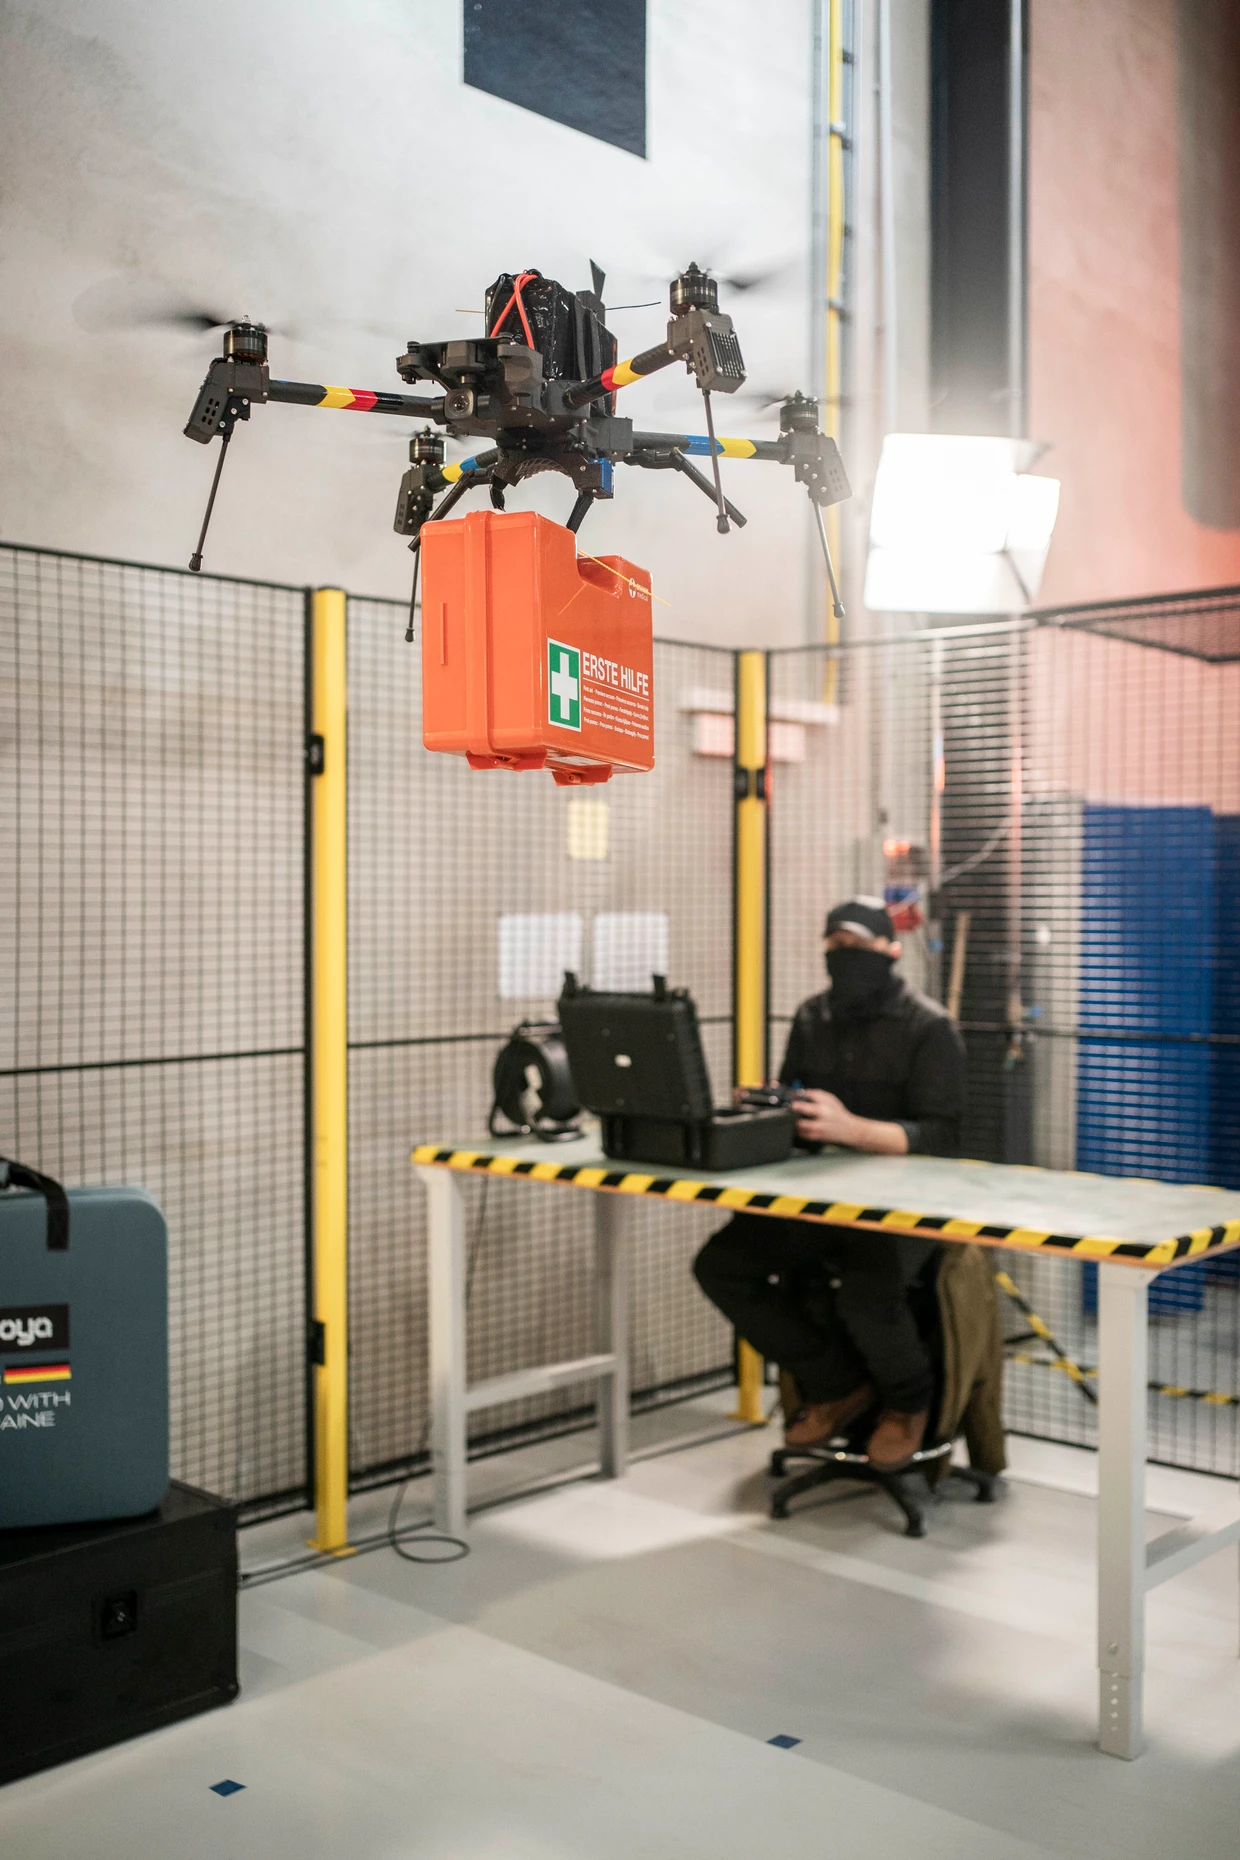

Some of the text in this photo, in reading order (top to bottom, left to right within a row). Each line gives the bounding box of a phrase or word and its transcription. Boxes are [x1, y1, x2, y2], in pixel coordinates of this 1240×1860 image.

[582, 651, 649, 696] ERSTE HILFE
[7, 1390, 71, 1411] WITH
